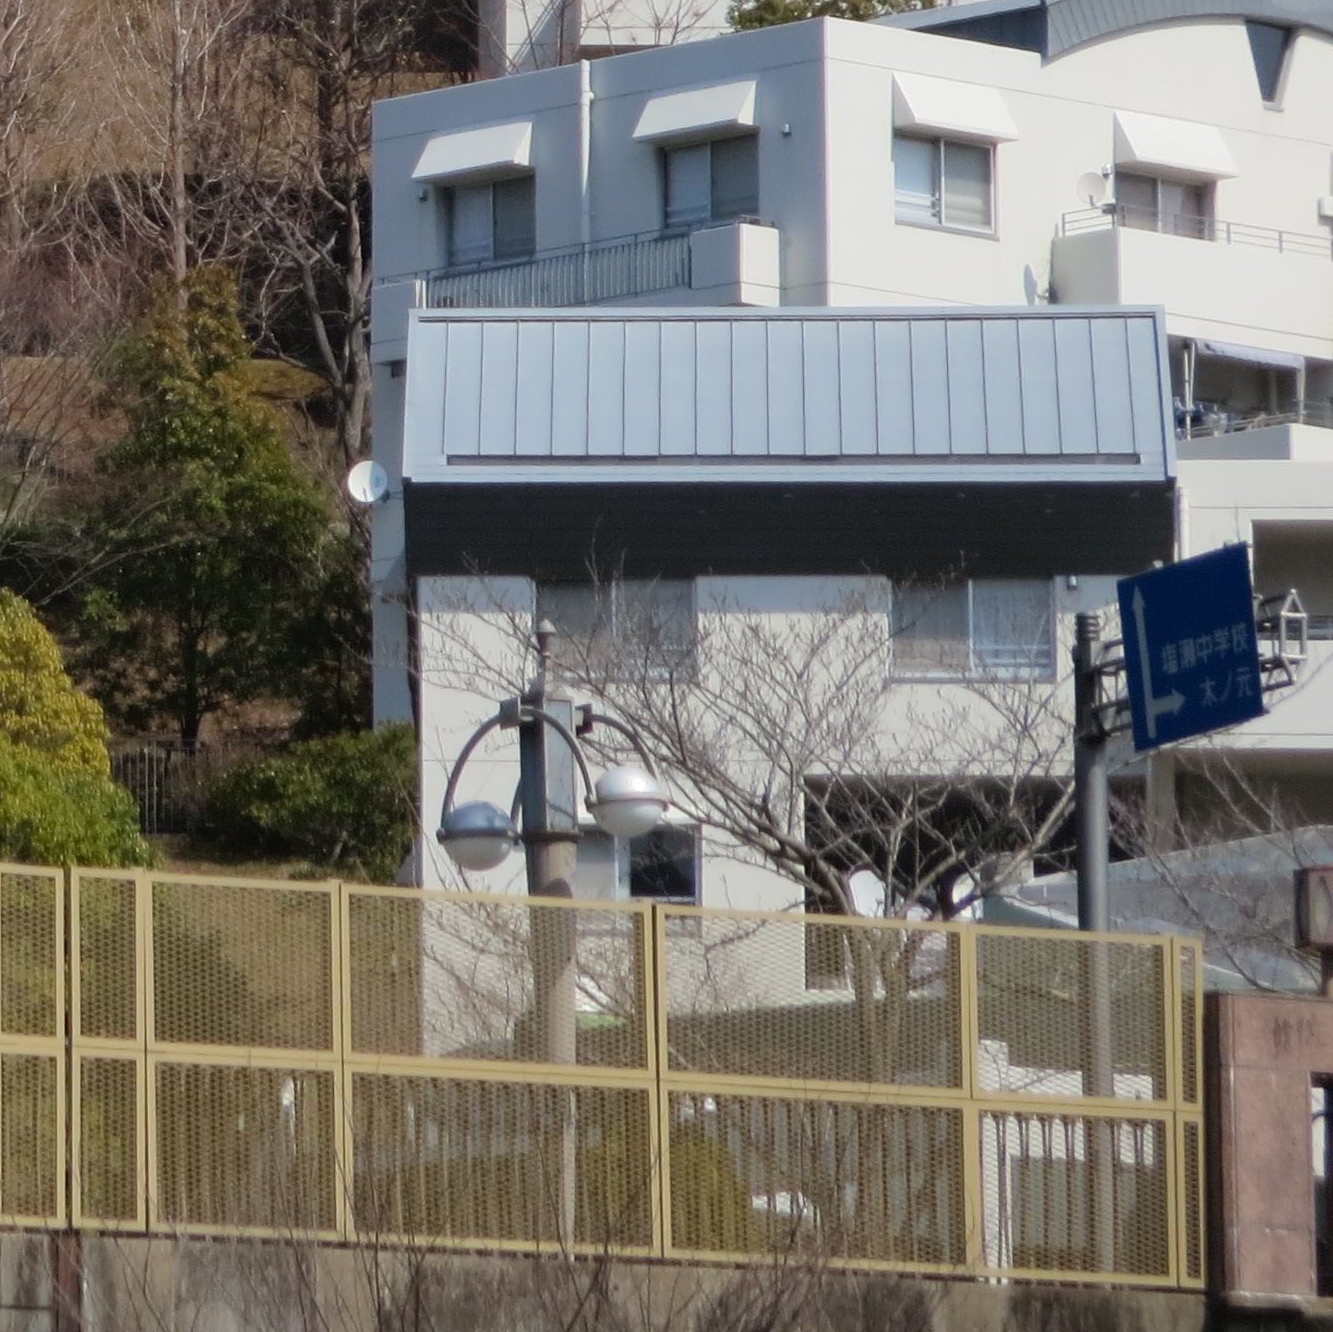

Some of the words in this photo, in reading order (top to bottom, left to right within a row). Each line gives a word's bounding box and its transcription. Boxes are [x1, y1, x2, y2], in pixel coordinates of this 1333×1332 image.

[1163, 622, 1248, 675] 塩瀬中学校
[1200, 667, 1253, 708] 木ノ元
